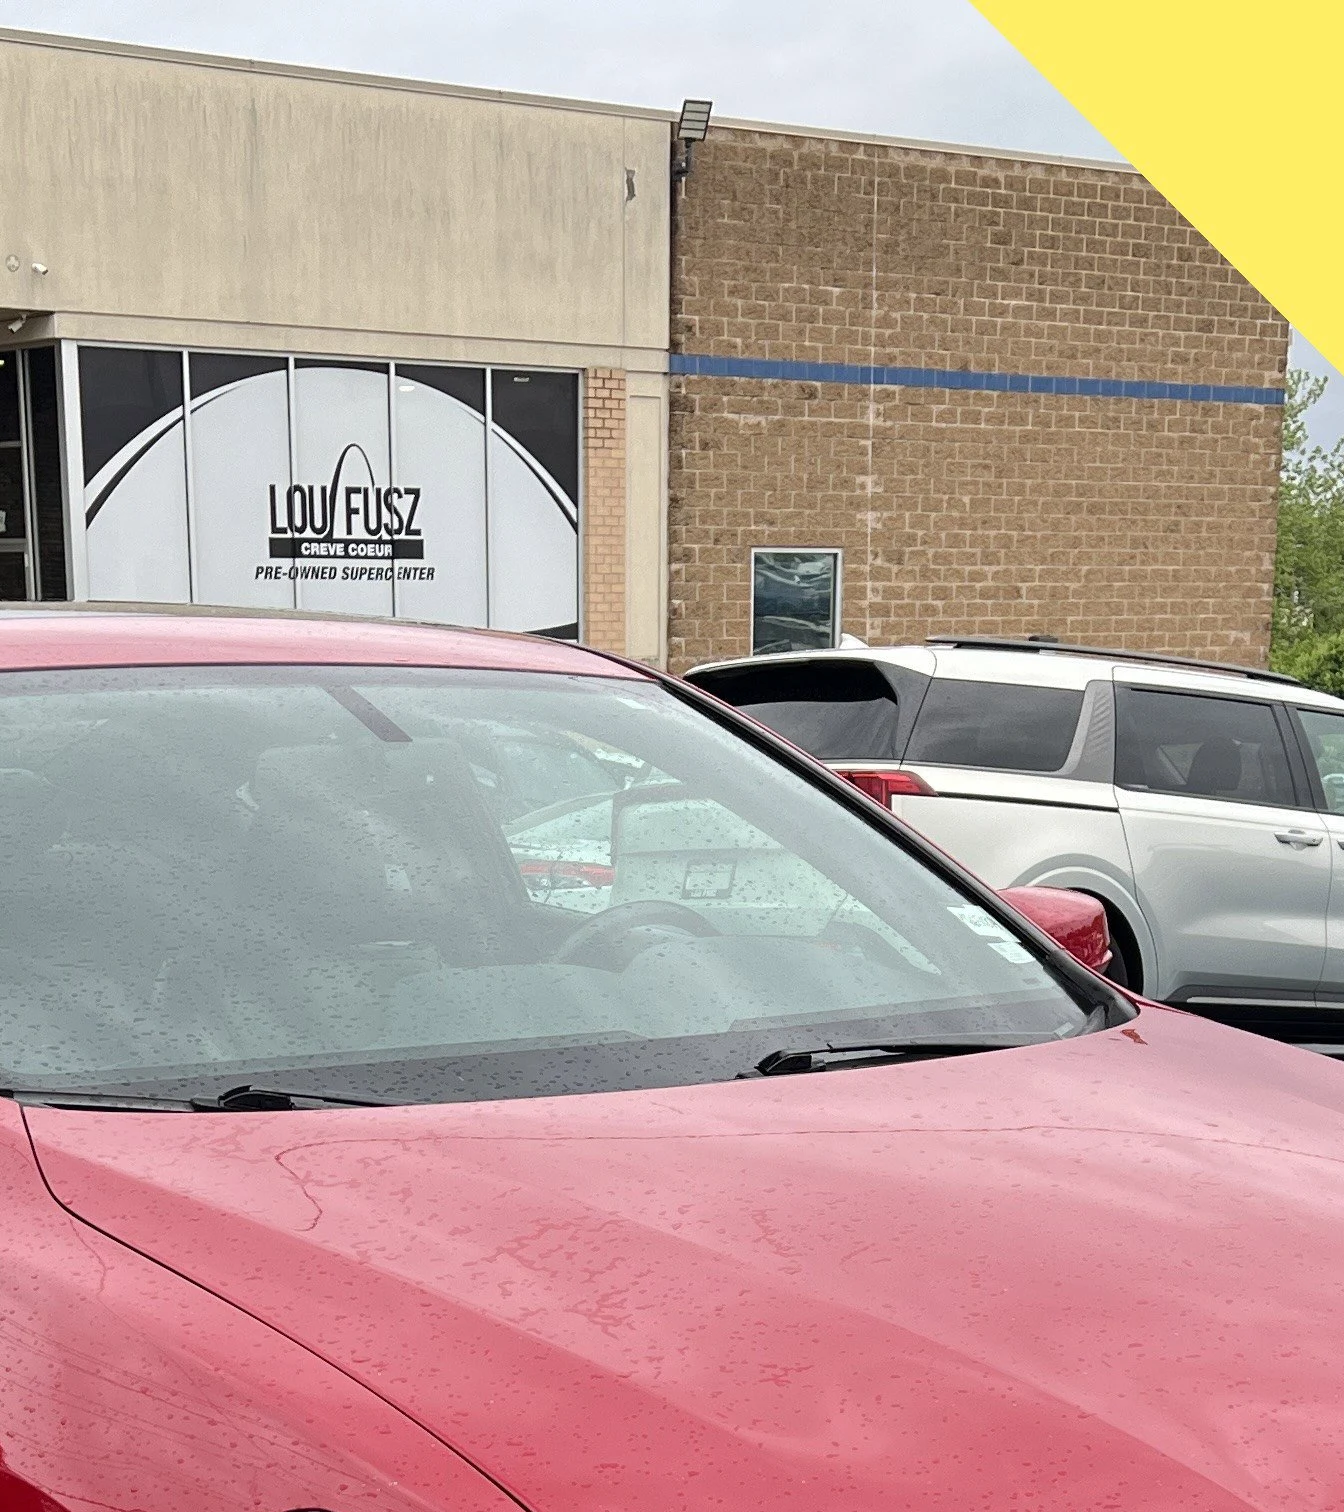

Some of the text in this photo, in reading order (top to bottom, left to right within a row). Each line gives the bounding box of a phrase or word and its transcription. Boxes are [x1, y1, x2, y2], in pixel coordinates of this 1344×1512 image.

[269, 484, 422, 536] LOU FUSZ
[300, 542, 393, 557] CREVE COEUR
[255, 566, 435, 581] PRE-OWNED SUPERCENTER
